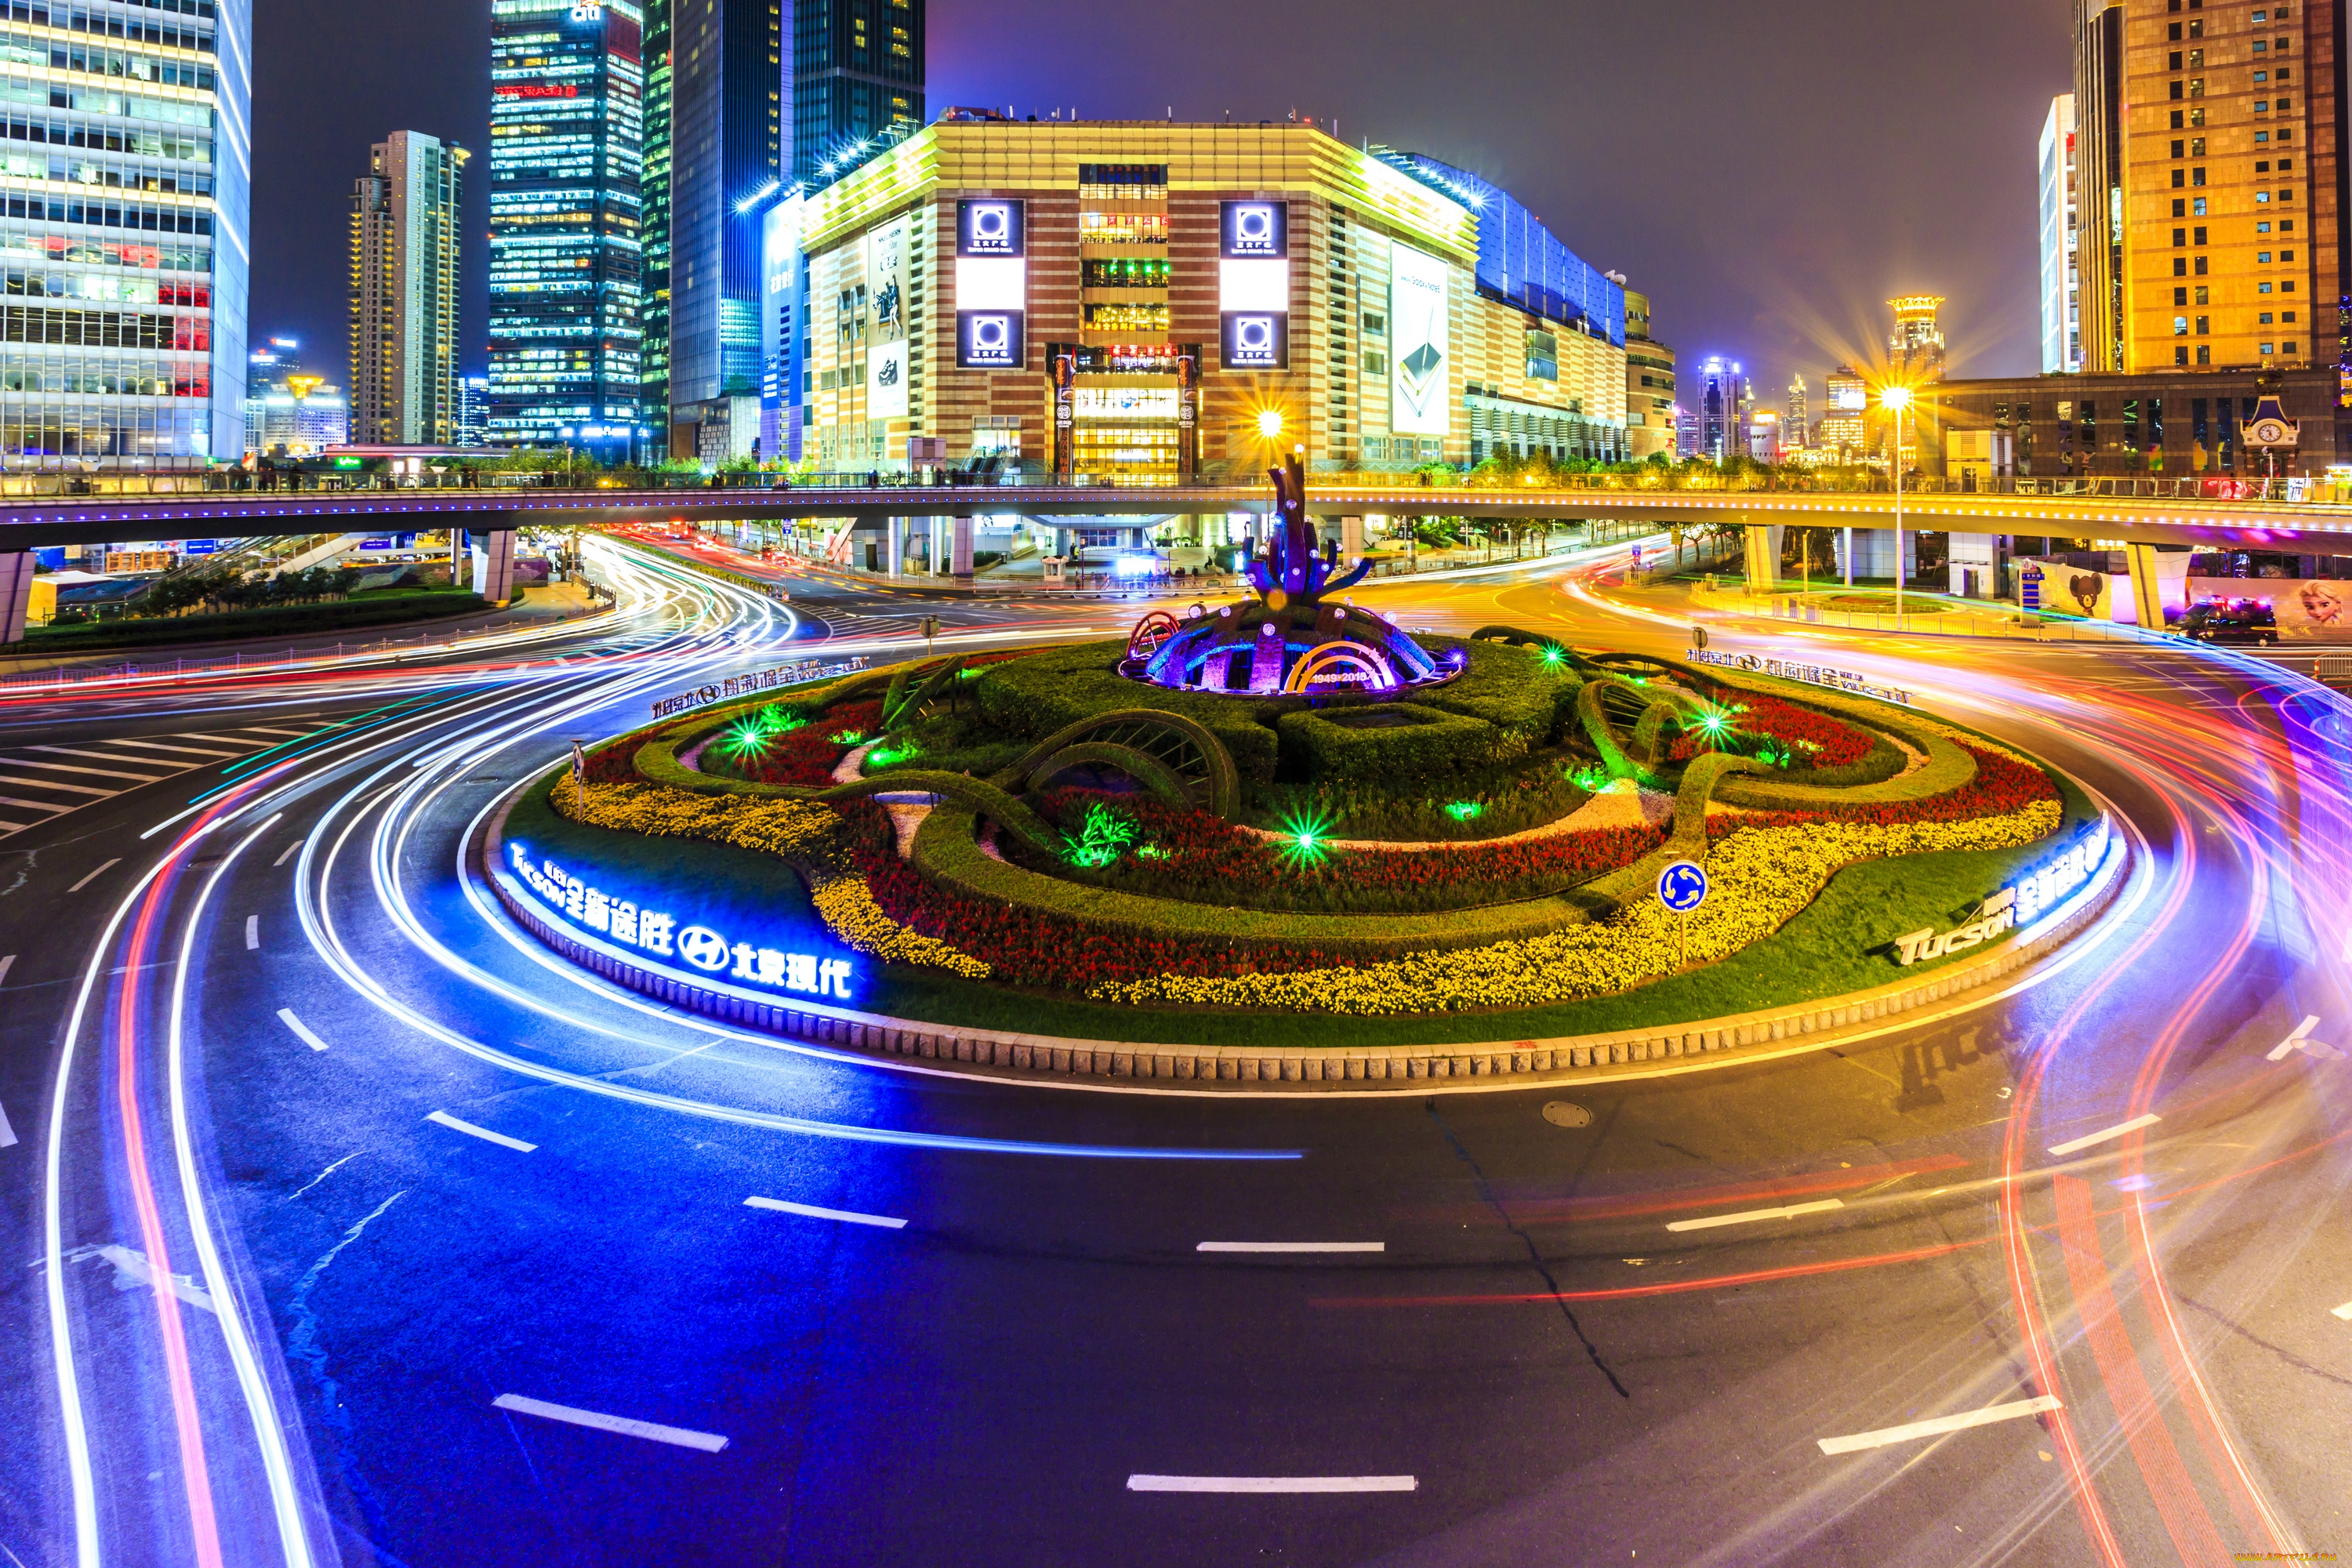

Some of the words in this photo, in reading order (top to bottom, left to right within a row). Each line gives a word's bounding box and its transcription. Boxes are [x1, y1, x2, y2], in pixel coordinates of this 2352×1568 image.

[572, 5, 600, 21] citi
[770, 268, 793, 295] 花旗银行
[1312, 672, 1367, 684] 1949-2015
[565, 877, 675, 956] 全新途胜
[731, 942, 853, 998] 北京现代
